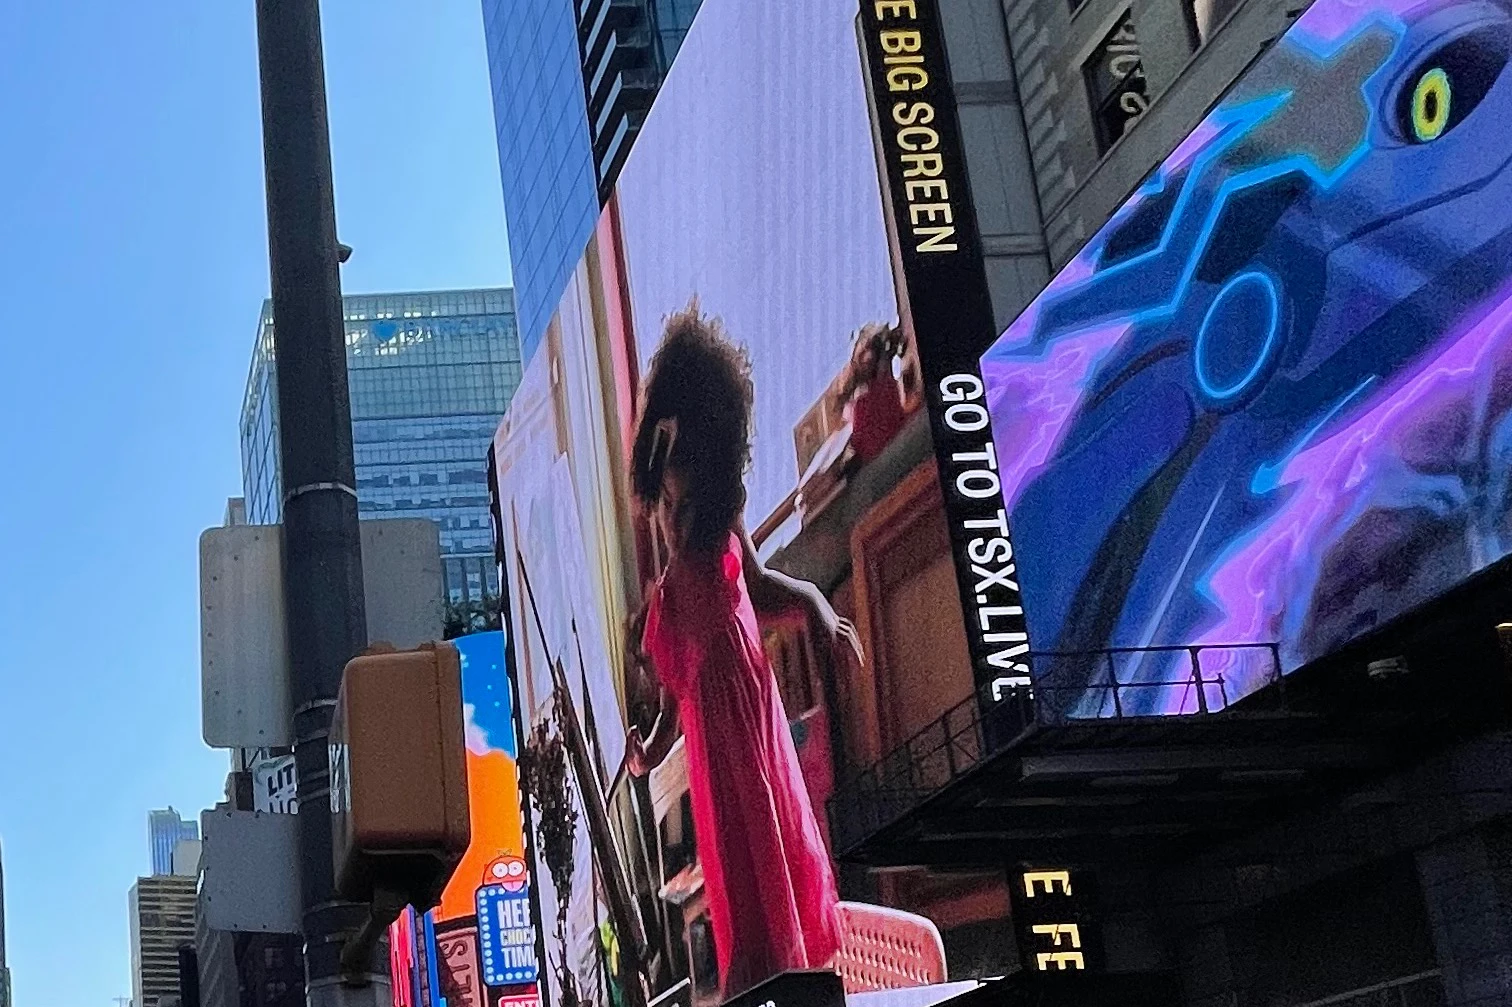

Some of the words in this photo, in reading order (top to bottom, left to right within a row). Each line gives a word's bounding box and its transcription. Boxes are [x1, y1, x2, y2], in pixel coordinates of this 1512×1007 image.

[880, 29, 929, 92] BIG
[892, 101, 958, 253] SCREEN
[939, 373, 990, 432] GO
[952, 442, 1002, 499] TO
[963, 509, 1035, 702] TSX.LIVE
